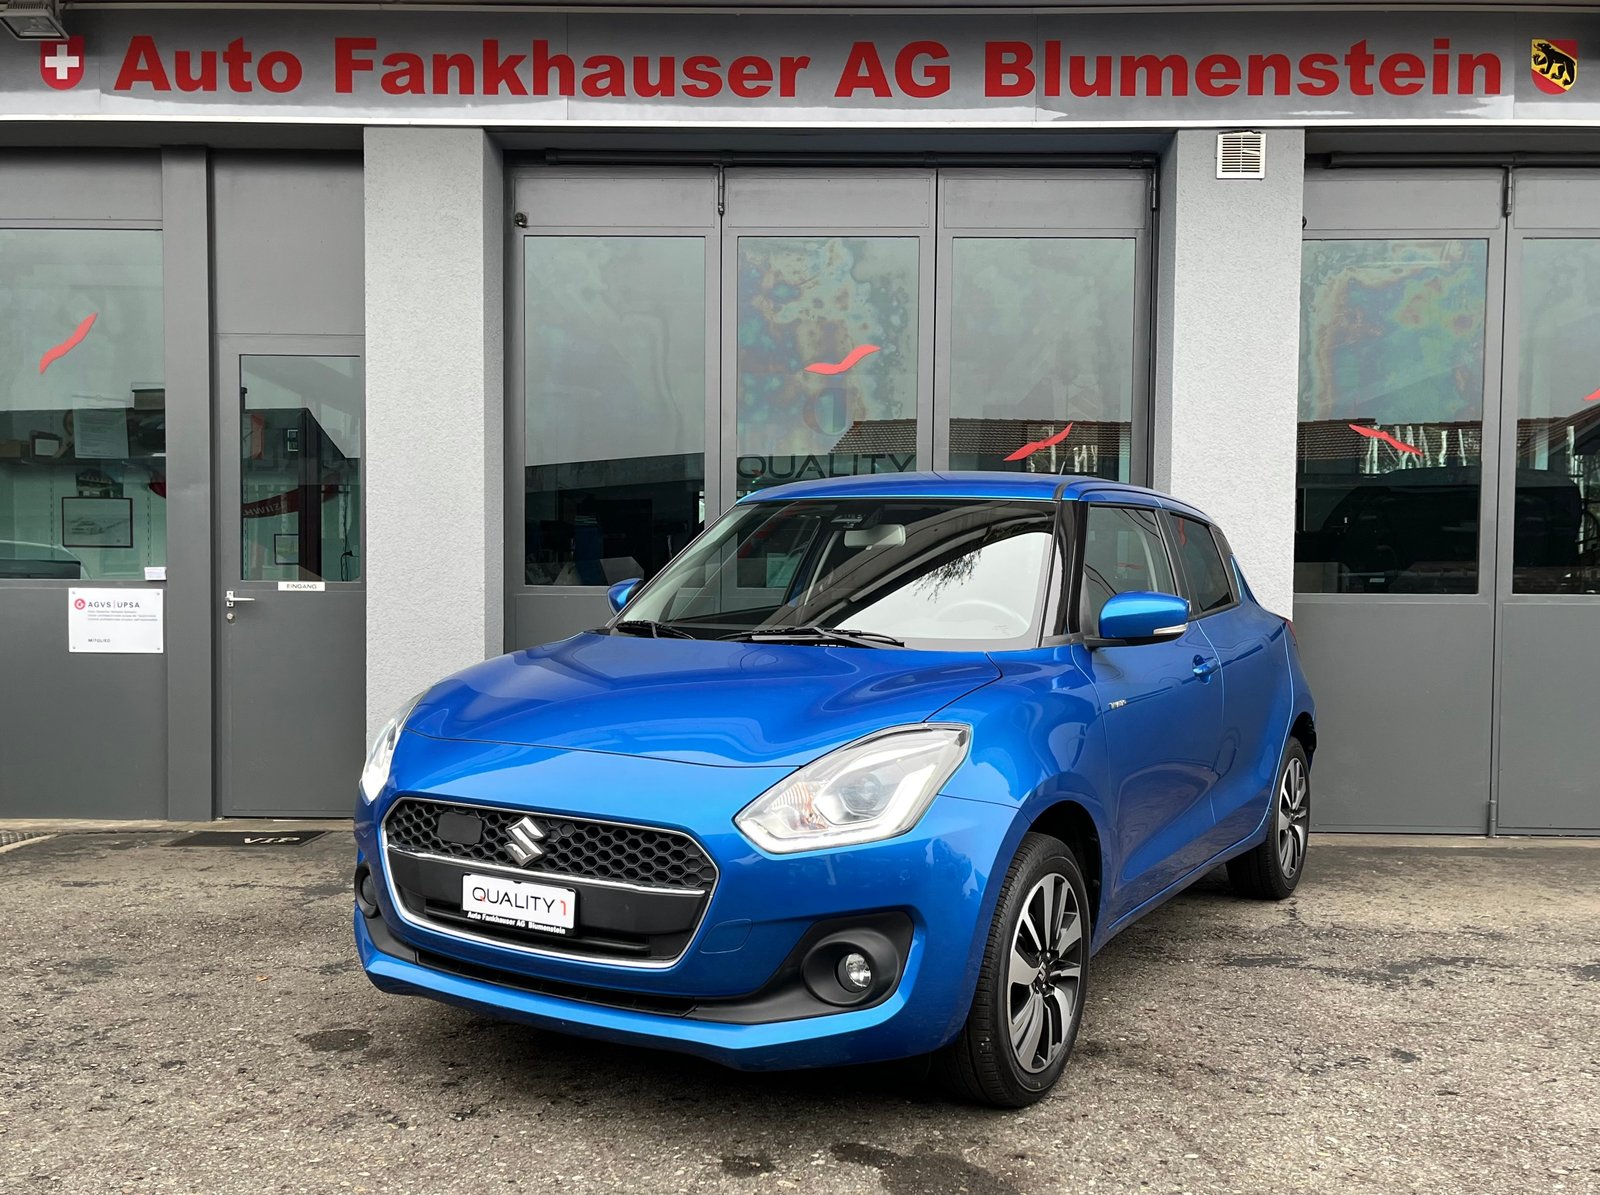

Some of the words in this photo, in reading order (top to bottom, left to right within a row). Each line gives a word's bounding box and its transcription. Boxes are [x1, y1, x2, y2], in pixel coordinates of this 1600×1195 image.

[116, 36, 302, 93] Auto
[335, 38, 809, 98] Fankhauser
[836, 41, 951, 98] AG
[985, 39, 1502, 97] Blumenstein
[737, 453, 916, 479] QUALITY
[472, 886, 555, 914] QUALITY
[560, 899, 567, 916] 1
[467, 911, 481, 920] Auto
[482, 913, 516, 926] Fankhauser
[528, 921, 566, 934] Blumenstein
